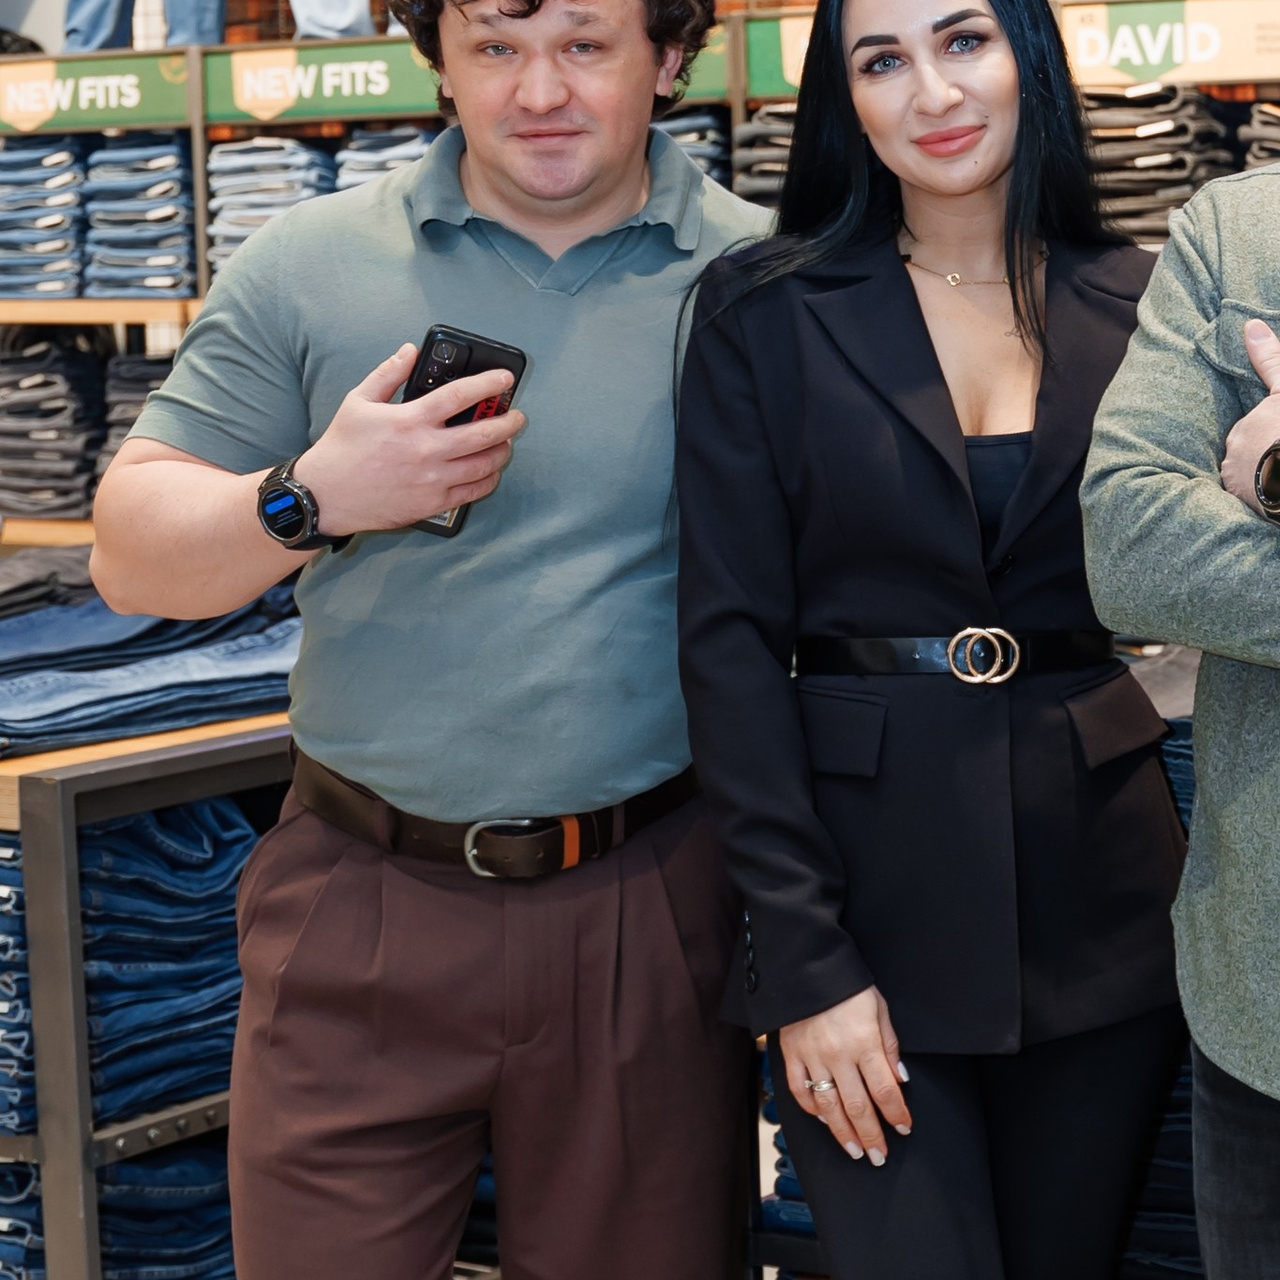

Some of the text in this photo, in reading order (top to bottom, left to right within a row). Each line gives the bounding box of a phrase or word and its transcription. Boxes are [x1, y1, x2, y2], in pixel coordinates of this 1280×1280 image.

[1077, 21, 1221, 67] DAVID
[5, 74, 141, 113] NEW FITS
[243, 60, 390, 101] NEW FITS
